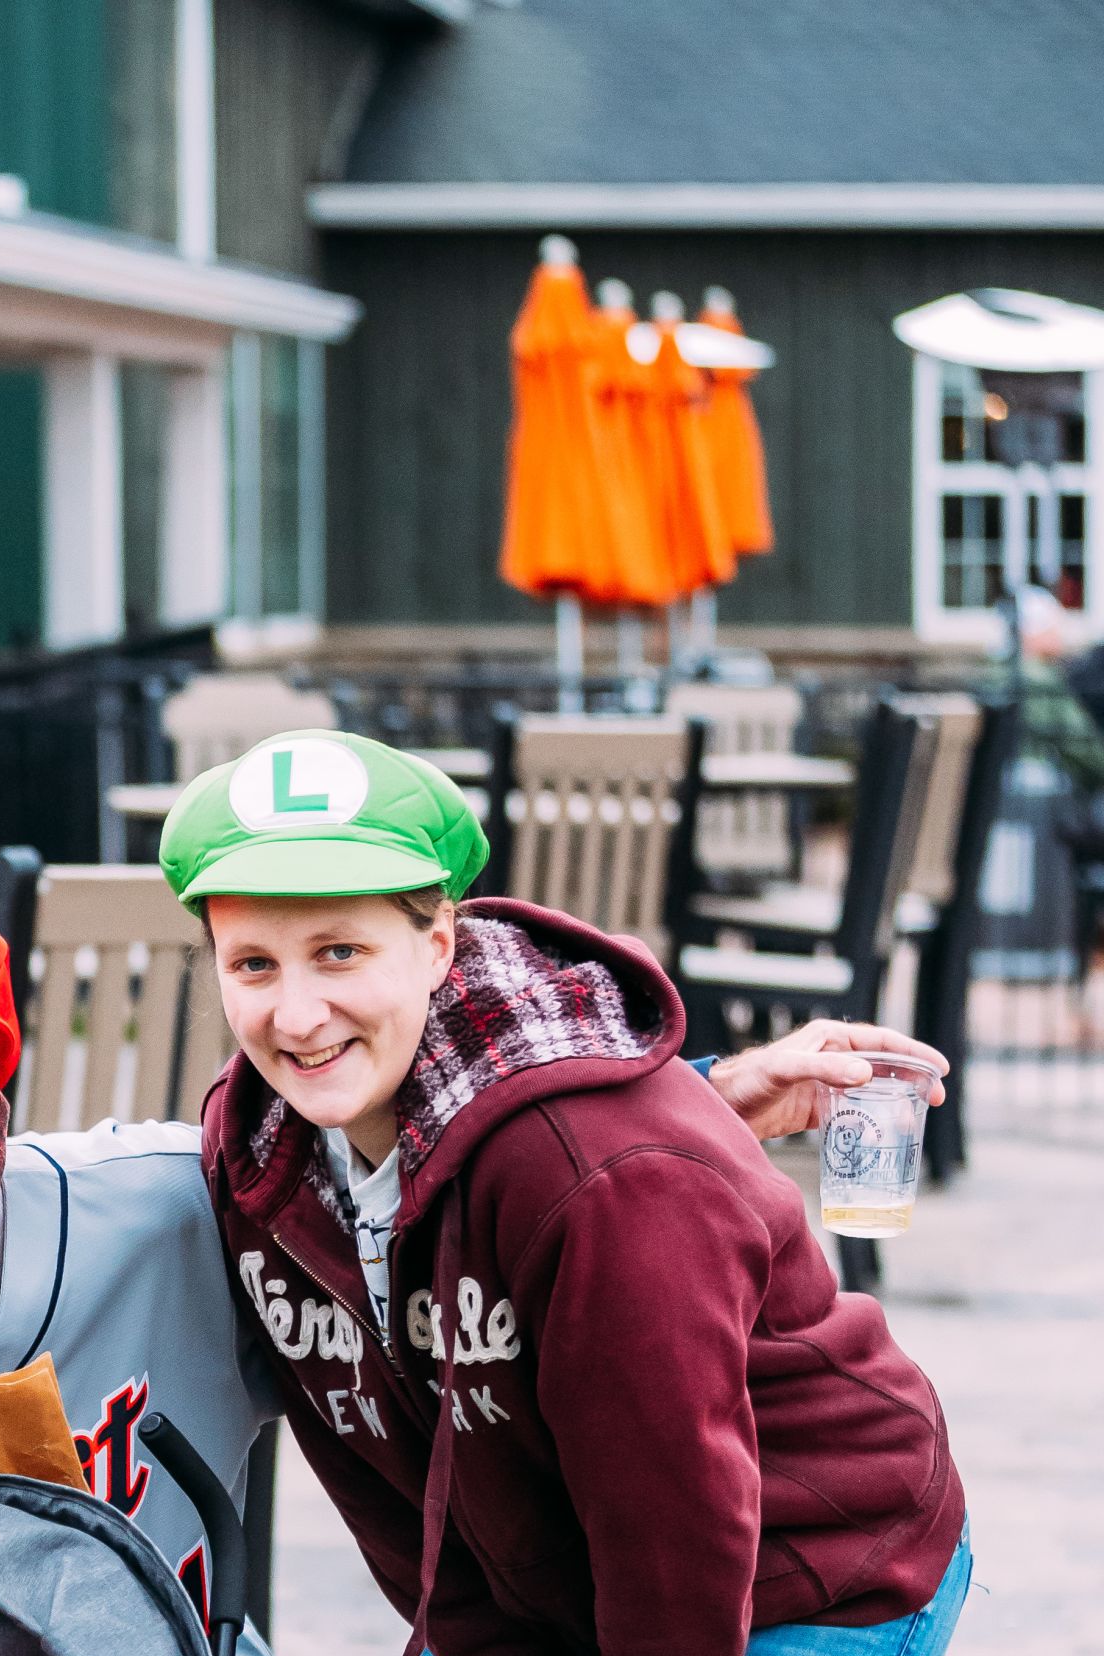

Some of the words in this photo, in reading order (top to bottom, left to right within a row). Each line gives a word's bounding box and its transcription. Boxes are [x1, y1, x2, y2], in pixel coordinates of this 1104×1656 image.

[272, 750, 329, 813] L
[857, 1111, 878, 1128] CIDER
[302, 1384, 387, 1440] EW
